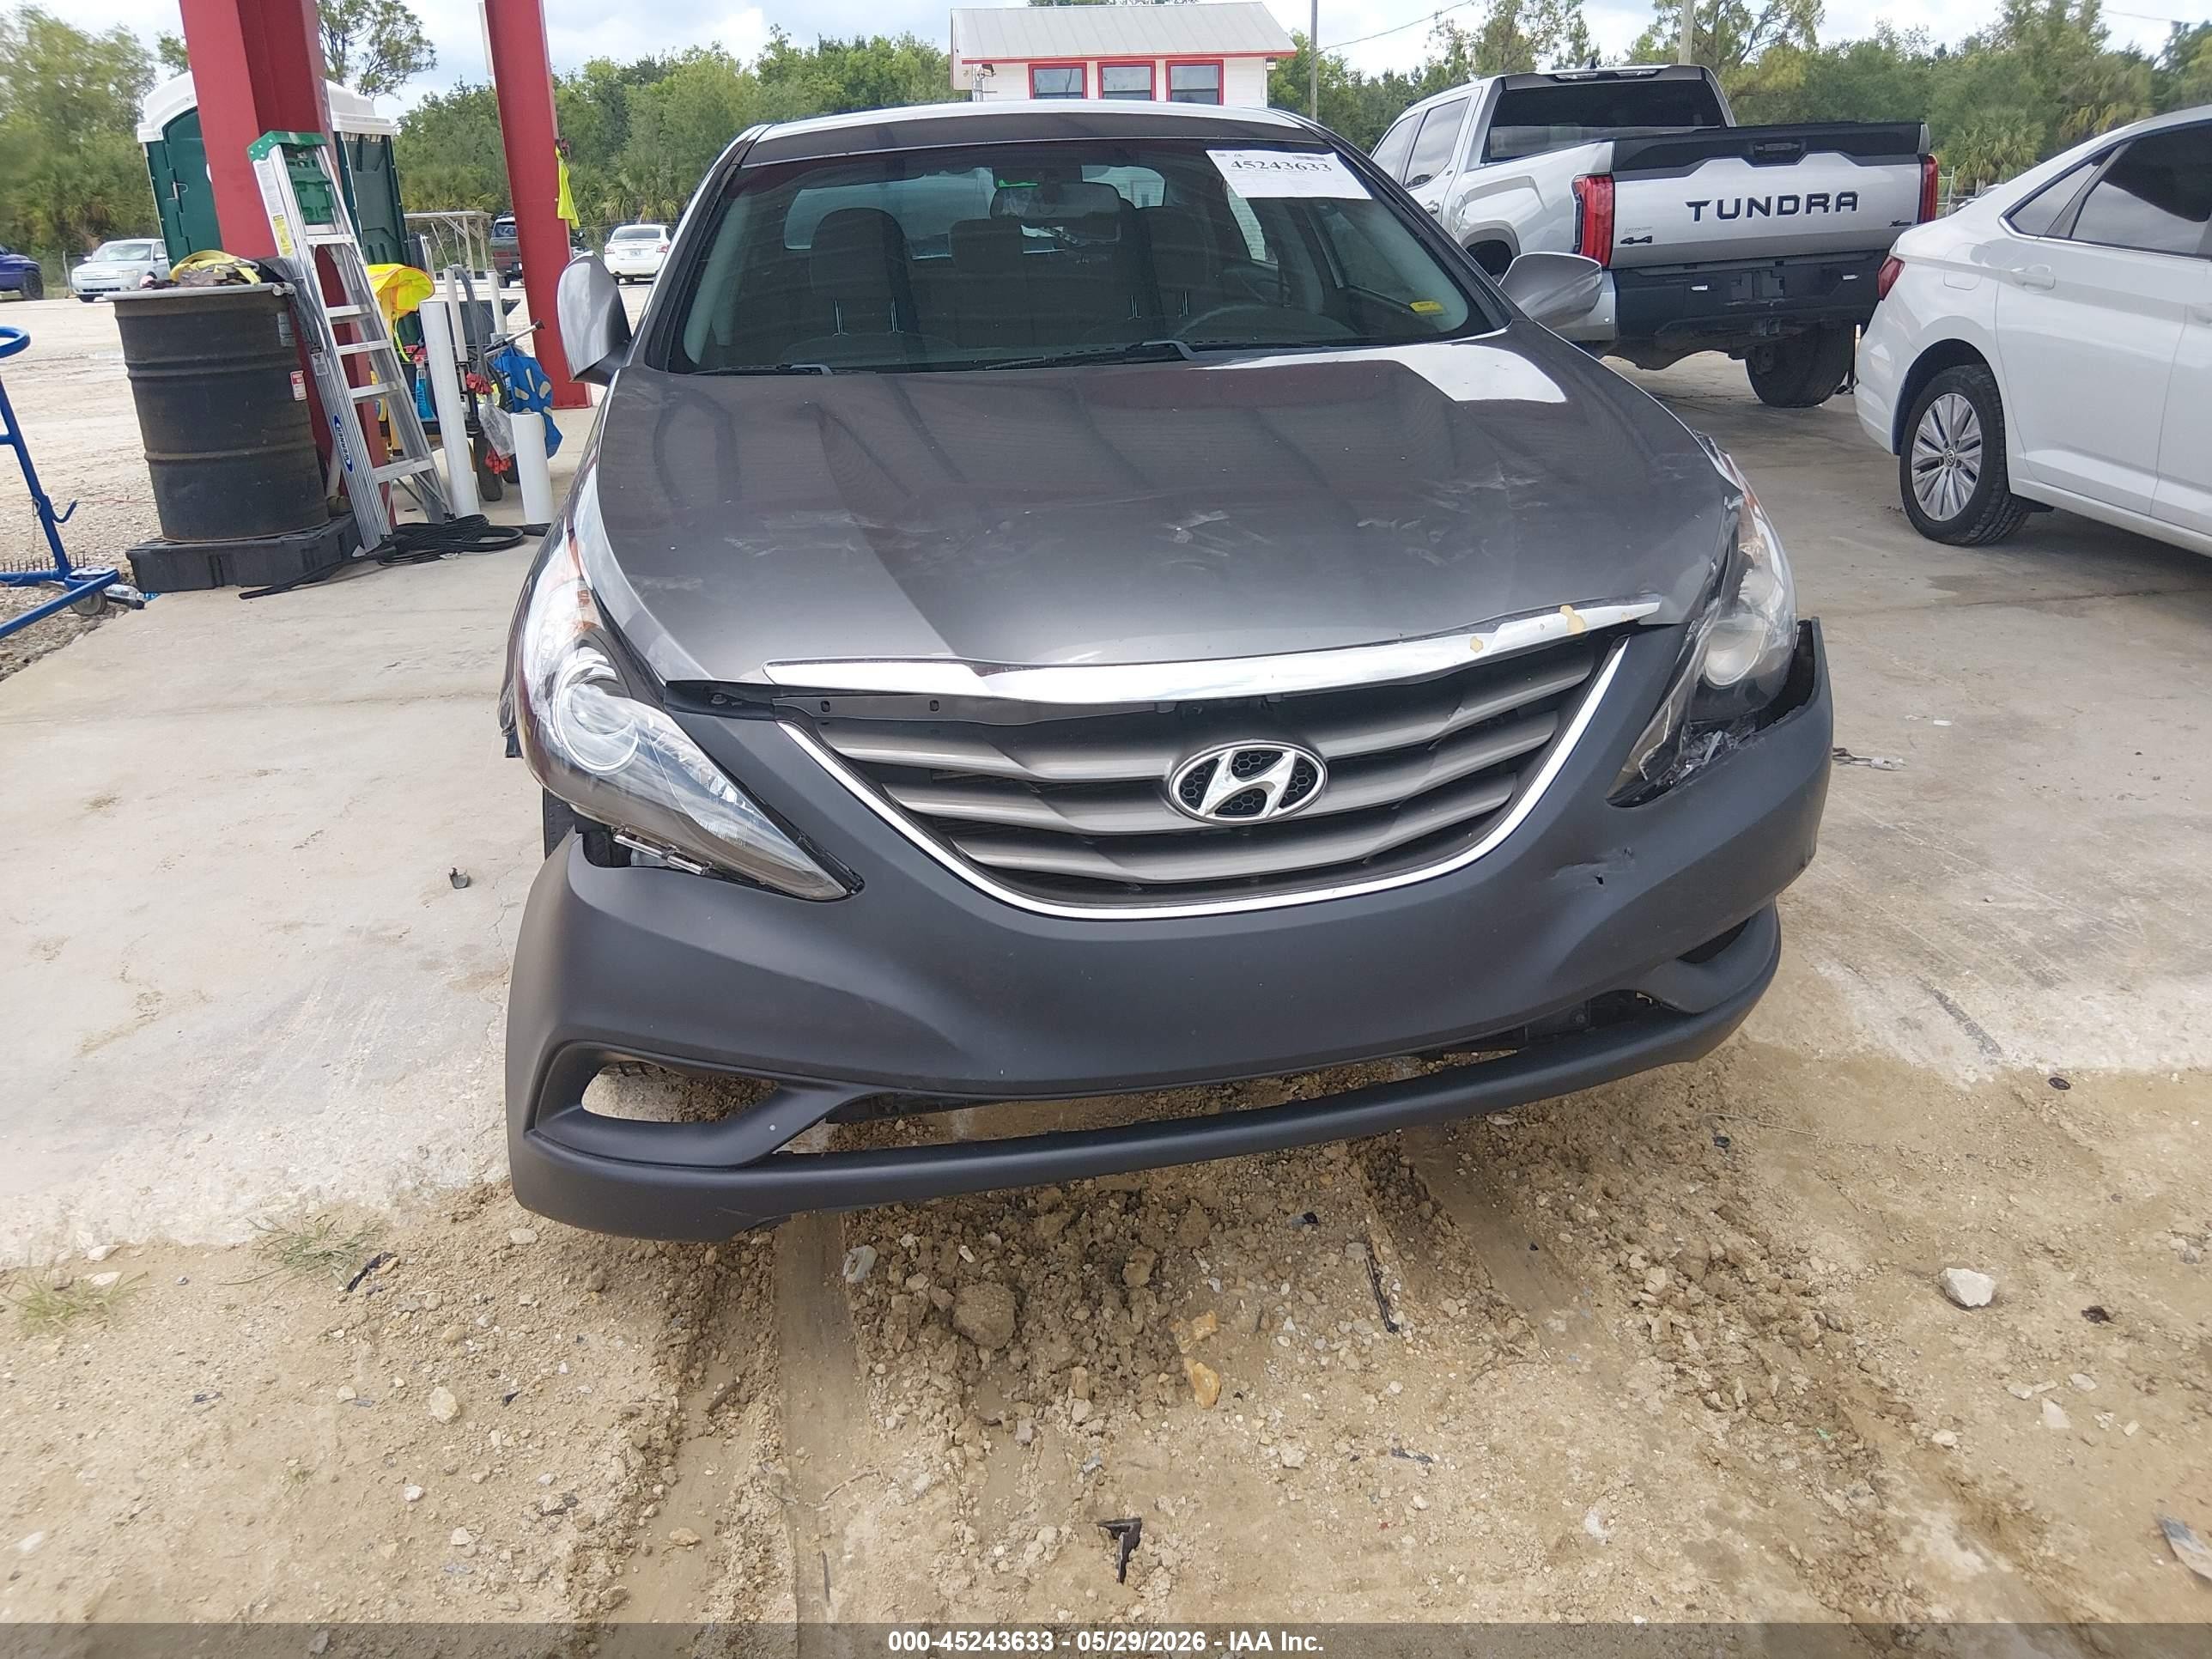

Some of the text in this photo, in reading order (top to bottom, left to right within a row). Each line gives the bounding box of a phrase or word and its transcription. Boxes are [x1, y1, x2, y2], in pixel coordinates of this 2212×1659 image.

[1231, 160, 1333, 173] 45243633
[1685, 191, 1858, 222] TUNDRA
[336, 425, 350, 461] WERNER
